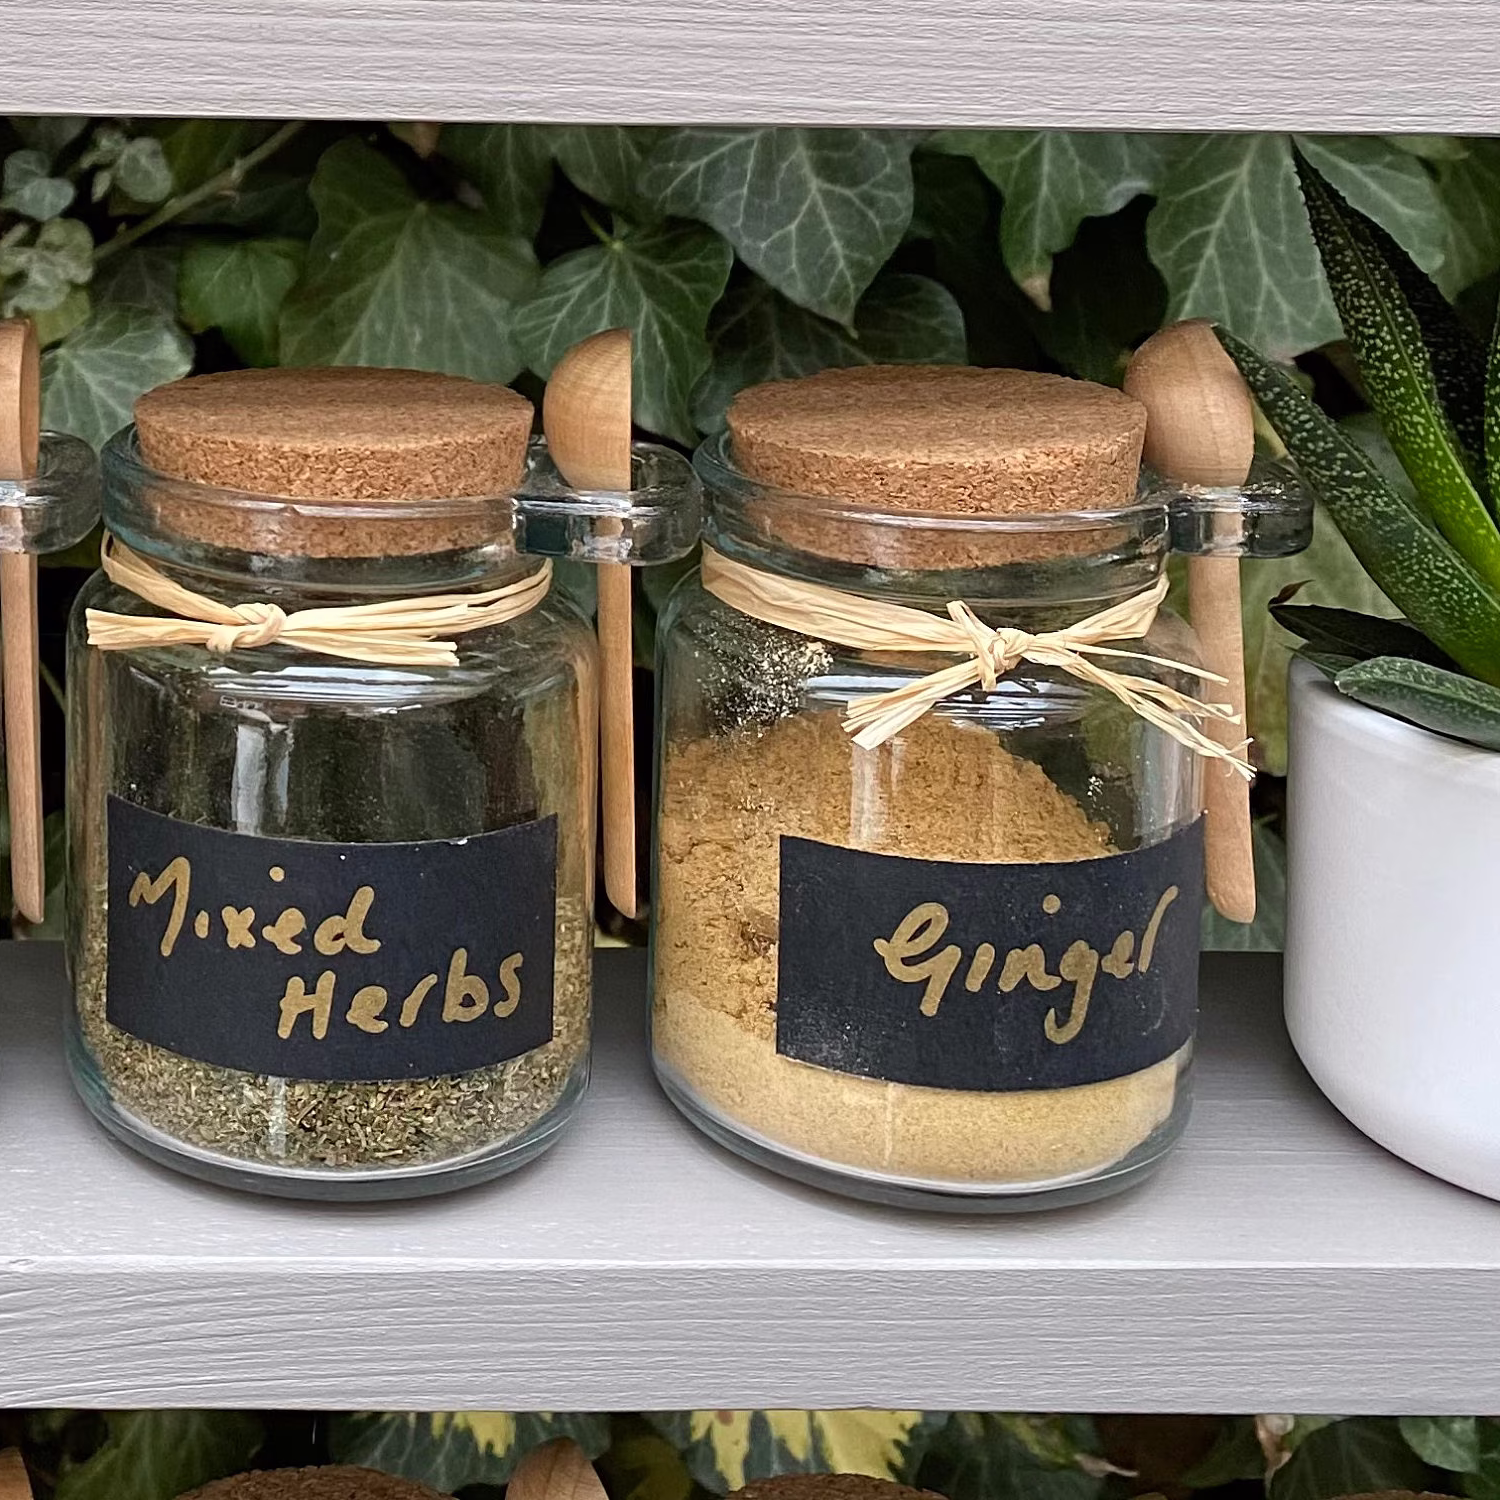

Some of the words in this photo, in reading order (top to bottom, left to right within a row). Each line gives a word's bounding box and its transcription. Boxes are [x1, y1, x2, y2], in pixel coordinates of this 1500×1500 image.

[128, 856, 382, 957] Mixed
[276, 947, 524, 1040] Herbs
[873, 885, 1179, 1045] Ginger
